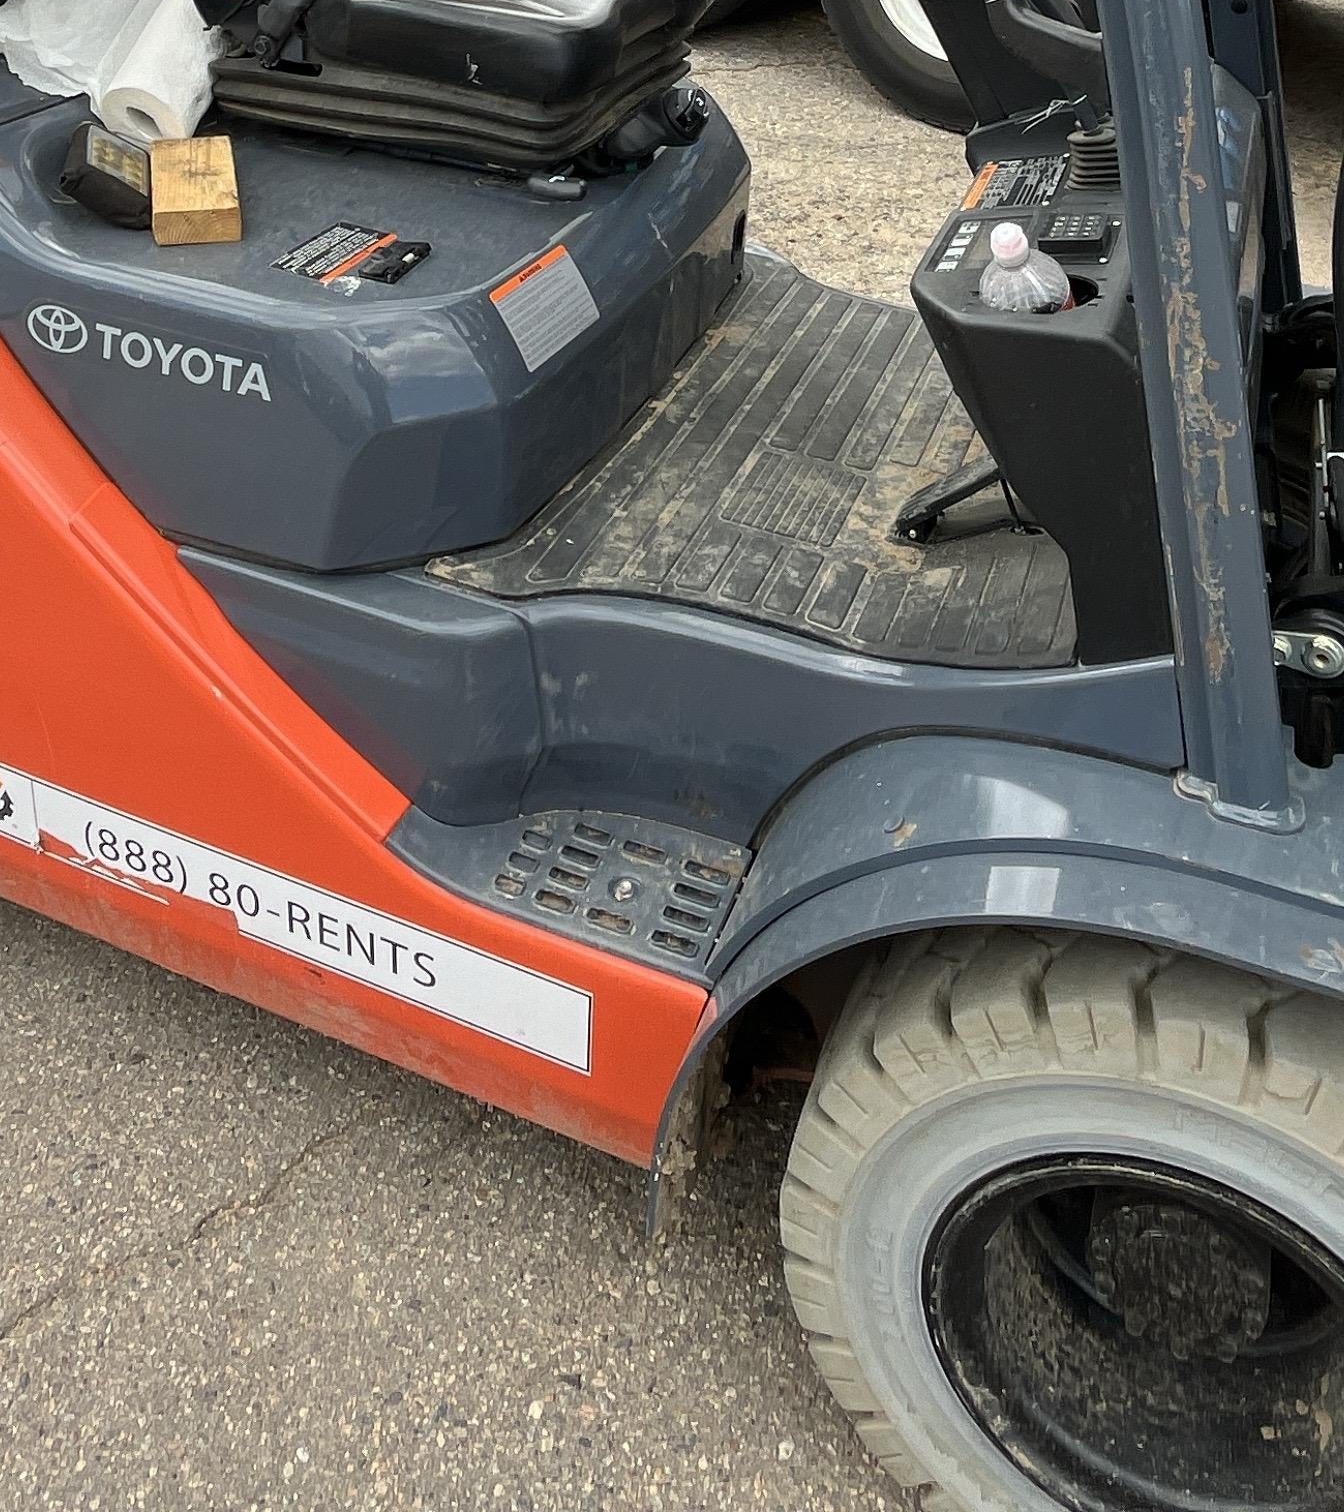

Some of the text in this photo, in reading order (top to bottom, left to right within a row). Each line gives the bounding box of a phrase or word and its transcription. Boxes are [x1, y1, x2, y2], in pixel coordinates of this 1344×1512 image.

[95, 322, 272, 402] TOYOTA
[85, 820, 438, 988] (888) 80-RENTS
